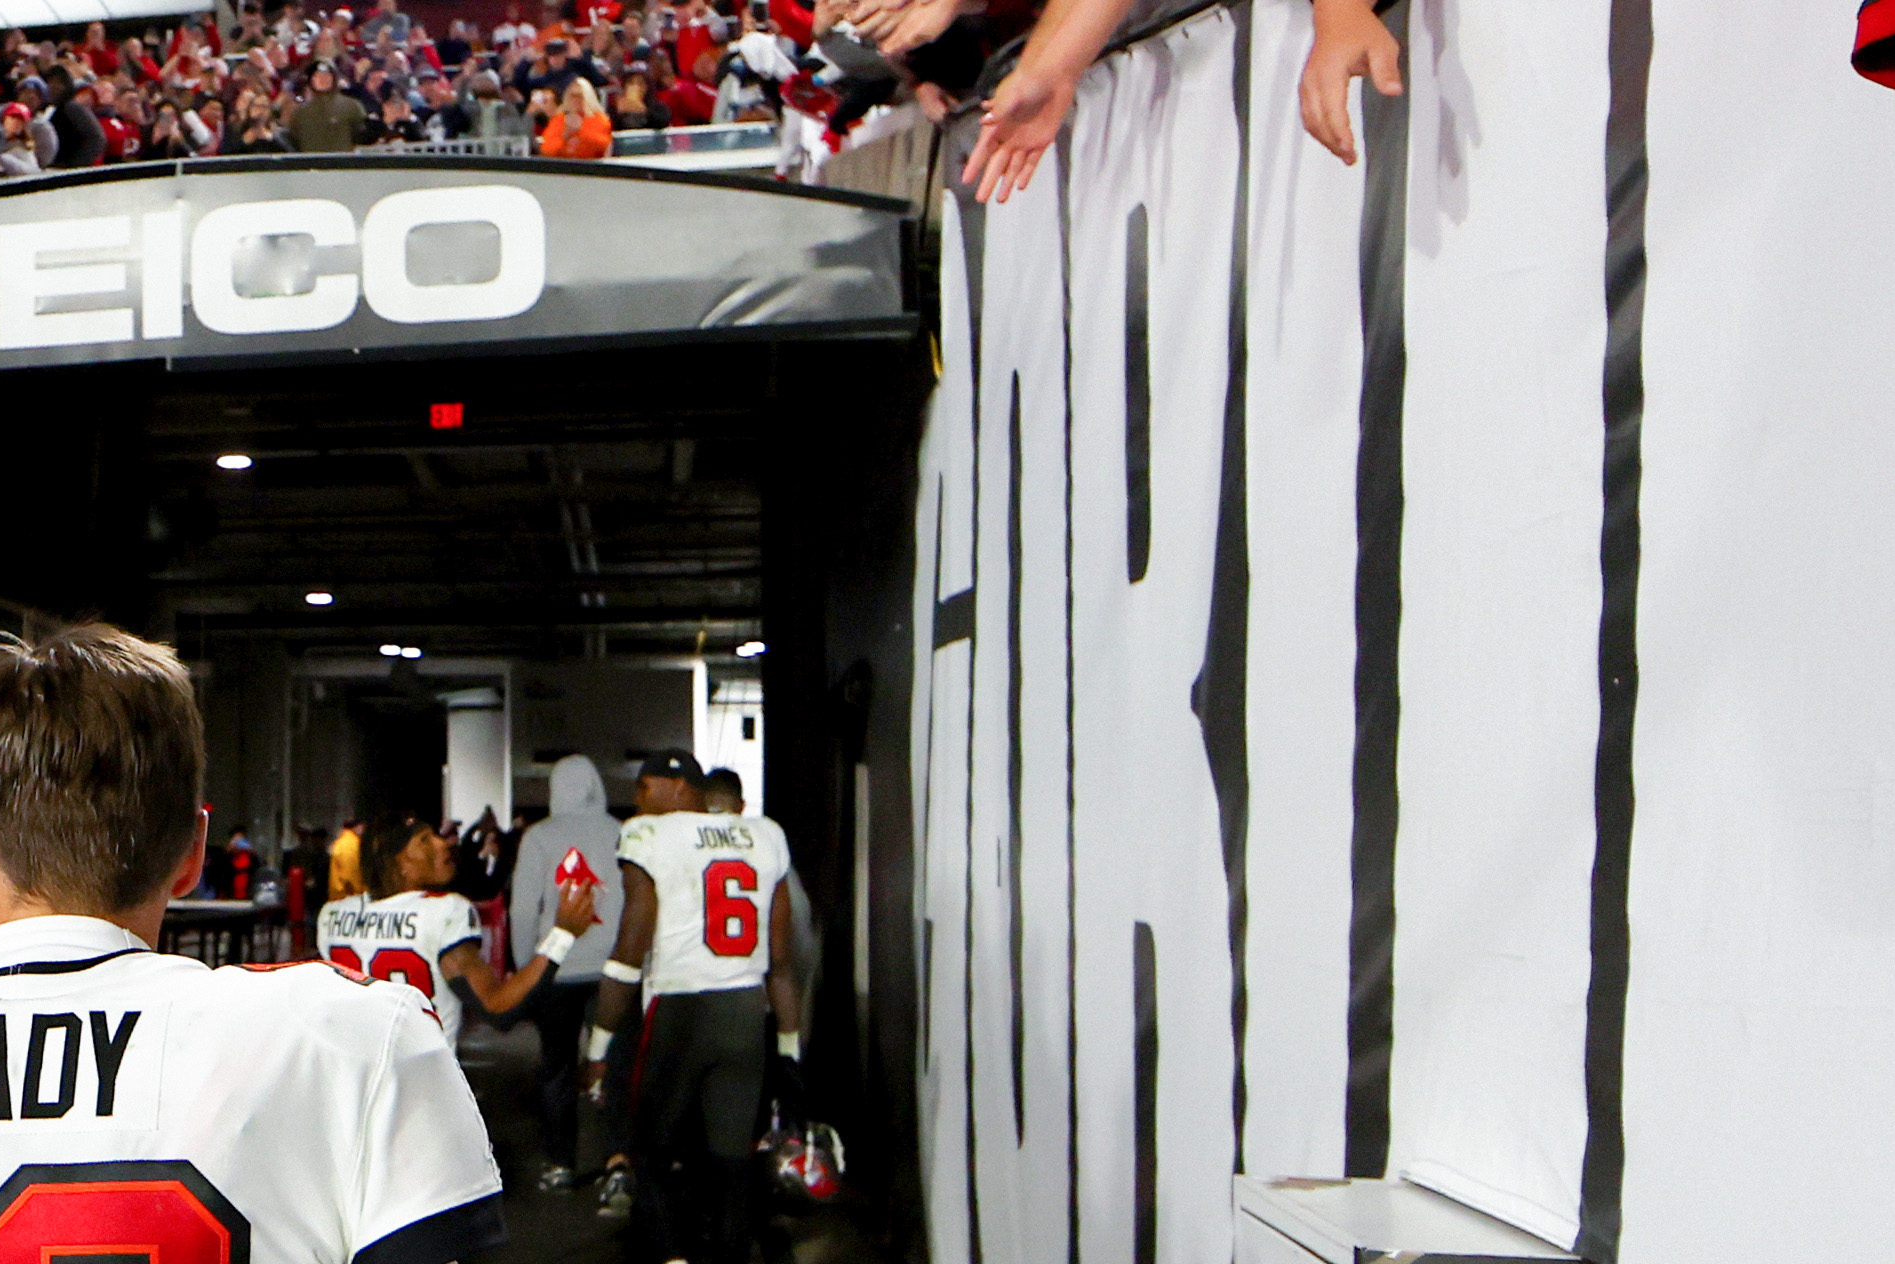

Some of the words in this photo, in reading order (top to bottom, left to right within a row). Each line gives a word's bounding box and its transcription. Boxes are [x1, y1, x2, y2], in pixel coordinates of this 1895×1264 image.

[695, 826, 754, 849] JONES
[703, 859, 759, 957] 6
[328, 909, 417, 939] THOMPKINS
